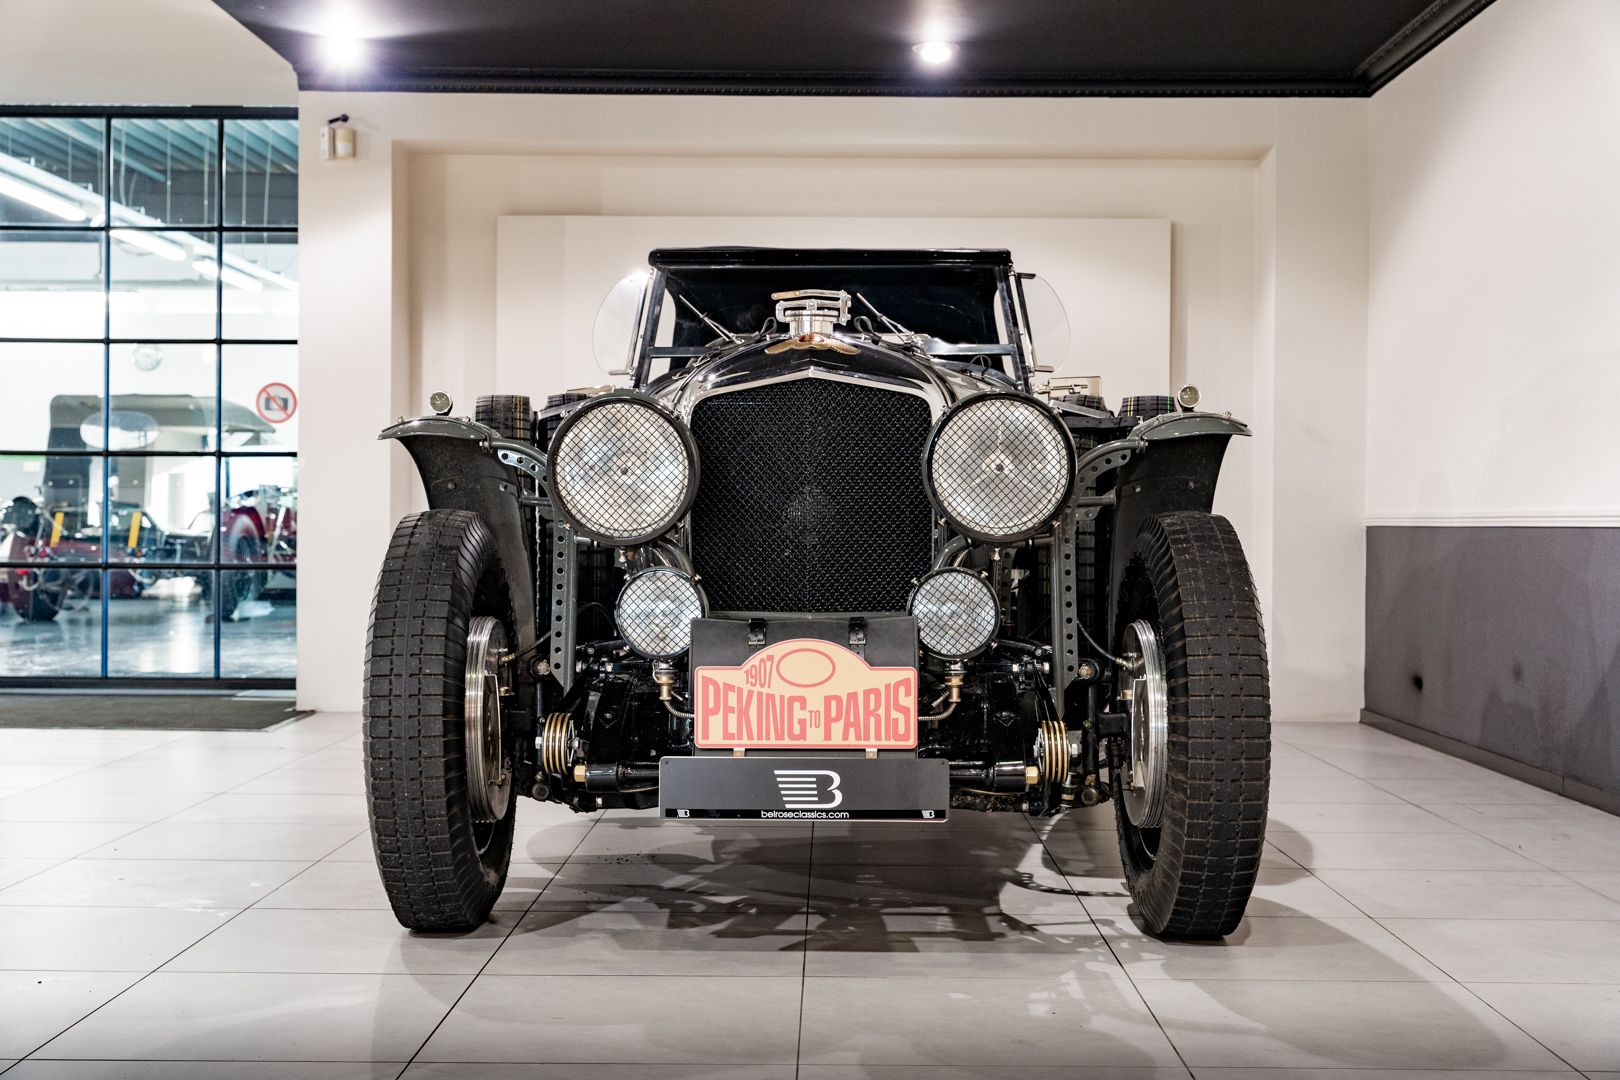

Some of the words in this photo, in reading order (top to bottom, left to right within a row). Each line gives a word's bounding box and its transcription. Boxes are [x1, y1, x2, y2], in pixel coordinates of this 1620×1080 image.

[744, 655, 775, 689] 1907
[702, 675, 807, 741] PEKING
[808, 710, 821, 729] TO
[823, 677, 912, 742] PARIS
[760, 809, 850, 819] belroseclassics.com
